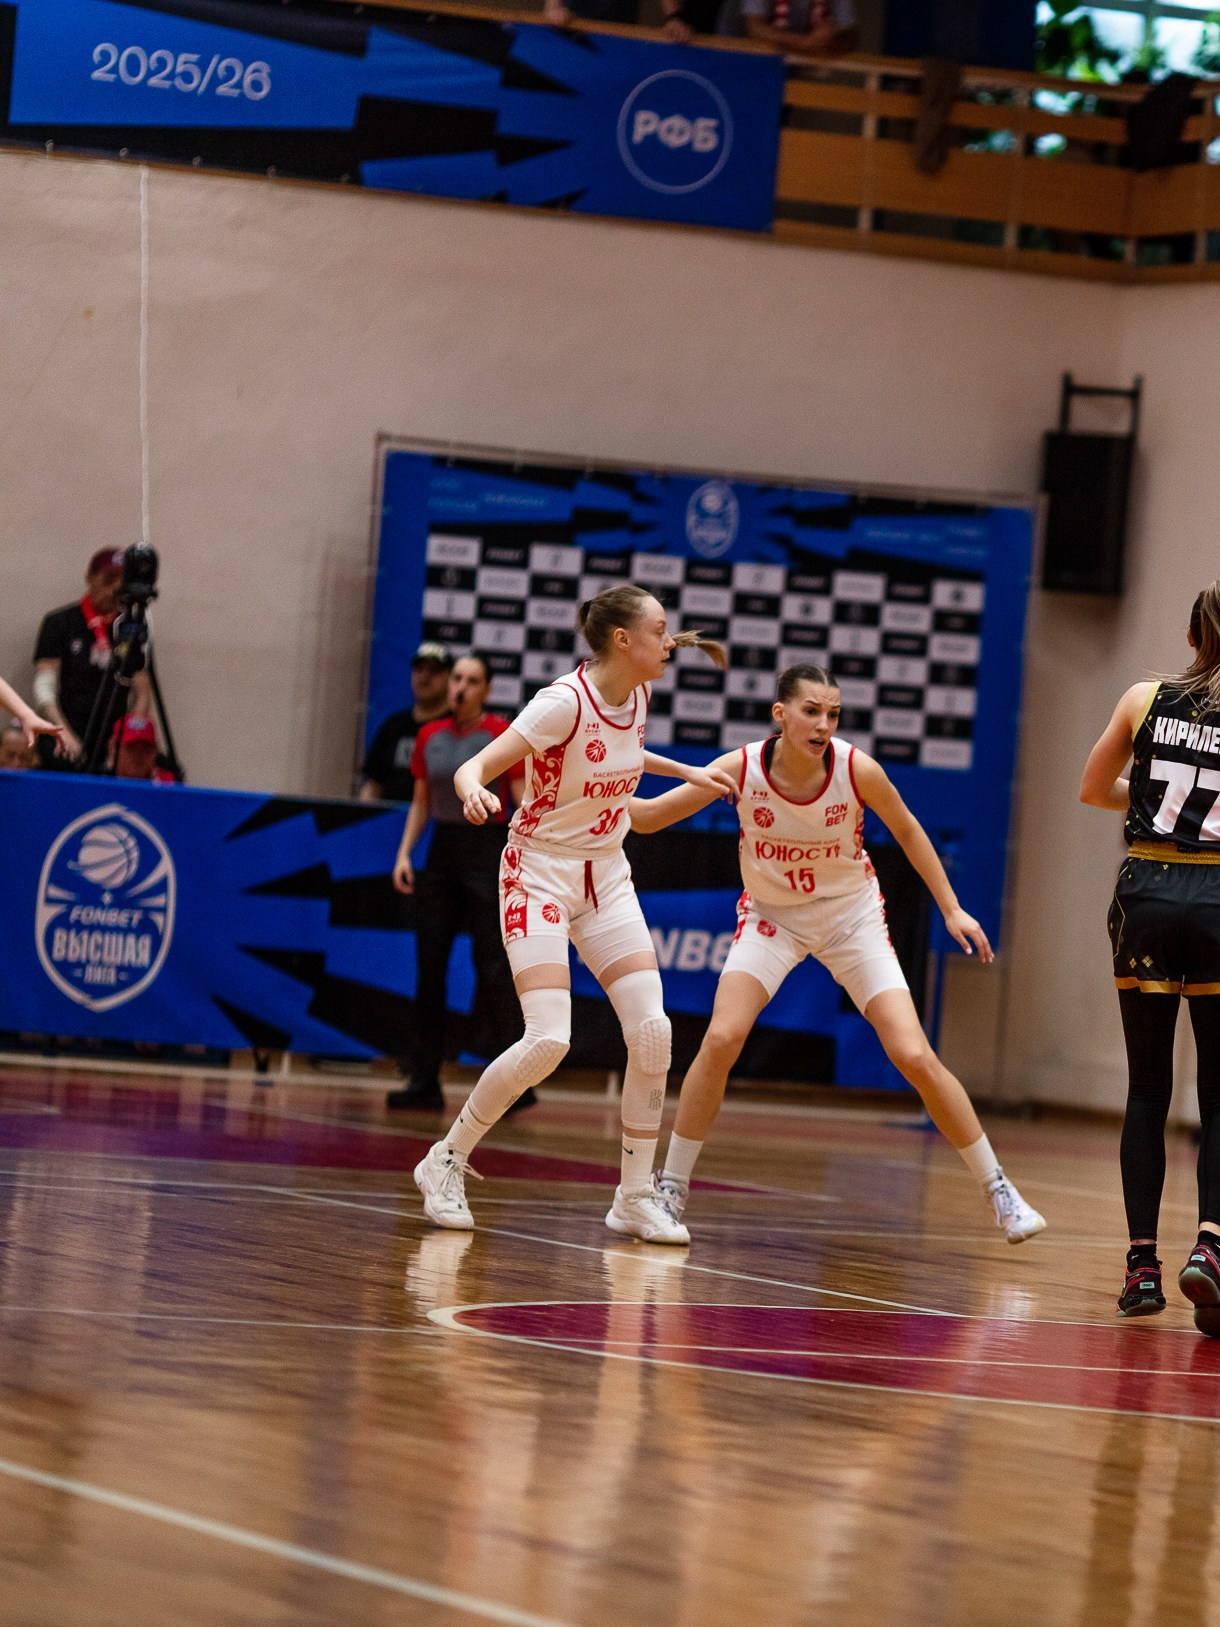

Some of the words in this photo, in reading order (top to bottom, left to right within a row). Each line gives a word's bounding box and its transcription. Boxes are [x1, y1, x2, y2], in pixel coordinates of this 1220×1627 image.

[90, 43, 272, 101] 2025/26
[632, 109, 720, 153] РФБ
[583, 774, 642, 799] ЮНОС
[825, 802, 848, 817] FON
[825, 812, 847, 828] BET
[784, 867, 816, 894] 15
[69, 904, 144, 929] FONBET
[52, 927, 152, 968] ВЫСШАЯ
[649, 926, 737, 973] NBE
